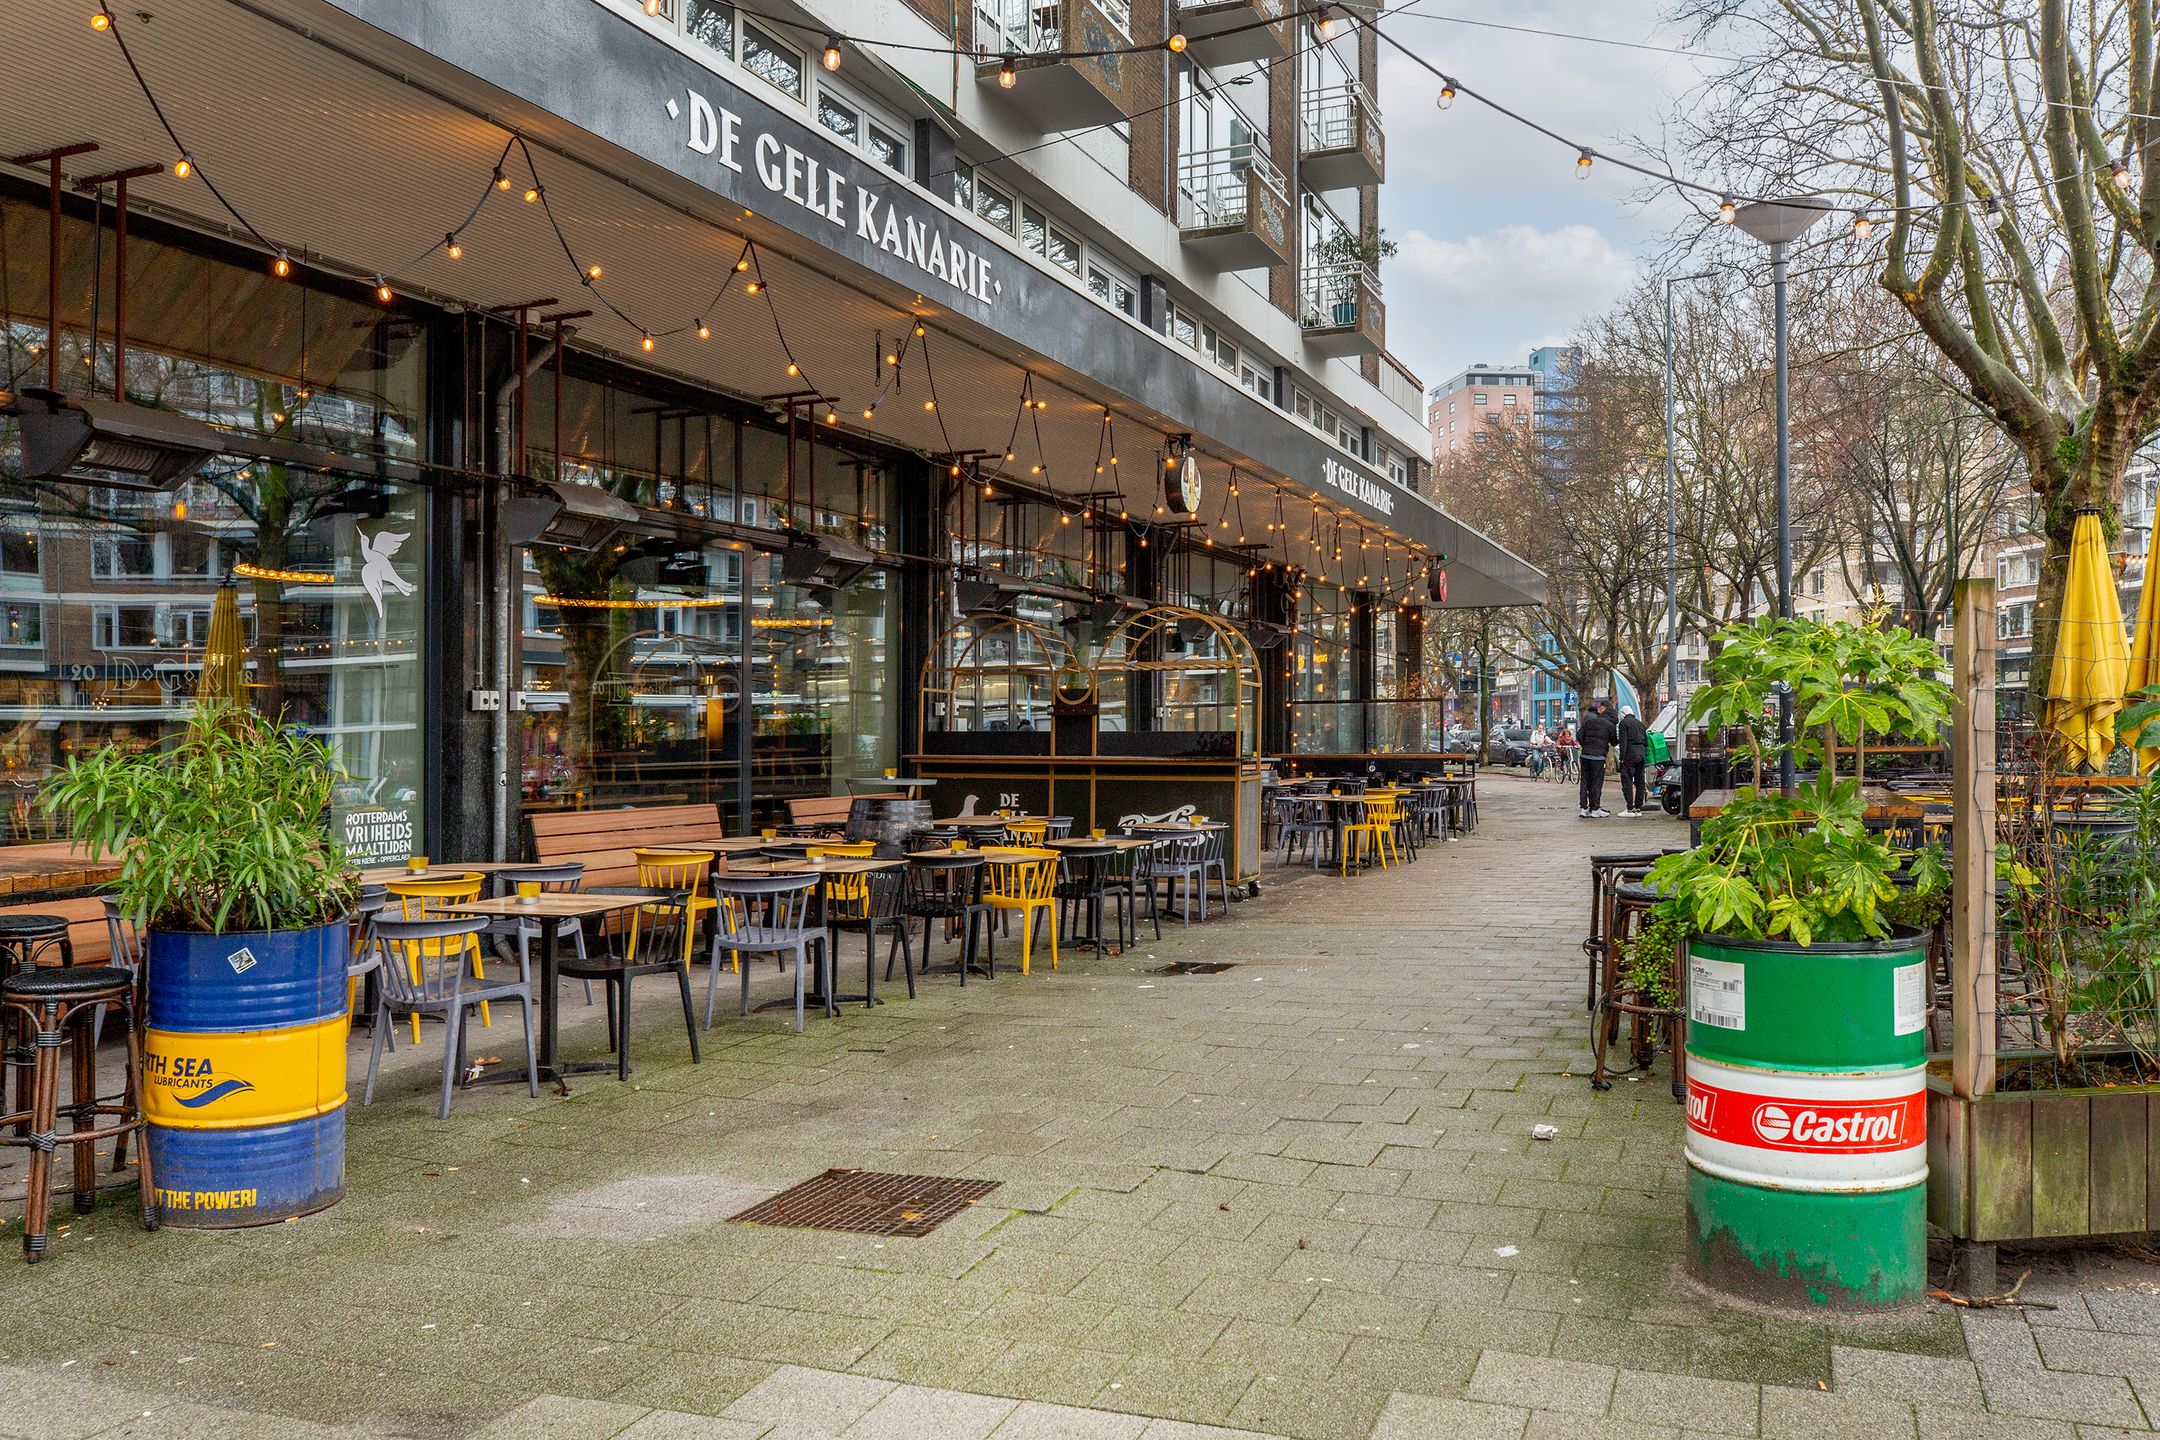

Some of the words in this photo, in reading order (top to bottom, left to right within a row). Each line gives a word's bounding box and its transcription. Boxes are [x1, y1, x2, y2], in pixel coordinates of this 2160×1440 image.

[686, 88, 743, 174] DE
[755, 133, 847, 228] GELE
[856, 185, 993, 305] KANARIE
[1326, 457, 1338, 487] DE
[1338, 465, 1358, 498] GELE
[1358, 476, 1392, 516] KANARIE
[71, 663, 96, 681] 20
[999, 793, 1020, 807] DE
[345, 809, 408, 825] ROTTERDAMS
[345, 822, 413, 843] VRIJHEIDS
[345, 839, 412, 857] MAALTIJDEN
[172, 1057, 213, 1078] SEA
[154, 1075, 214, 1089] LUBRICANTS
[1791, 1108, 1898, 1143] Castrol
[166, 1189, 192, 1210] THE
[194, 1188, 257, 1211] POWER!
